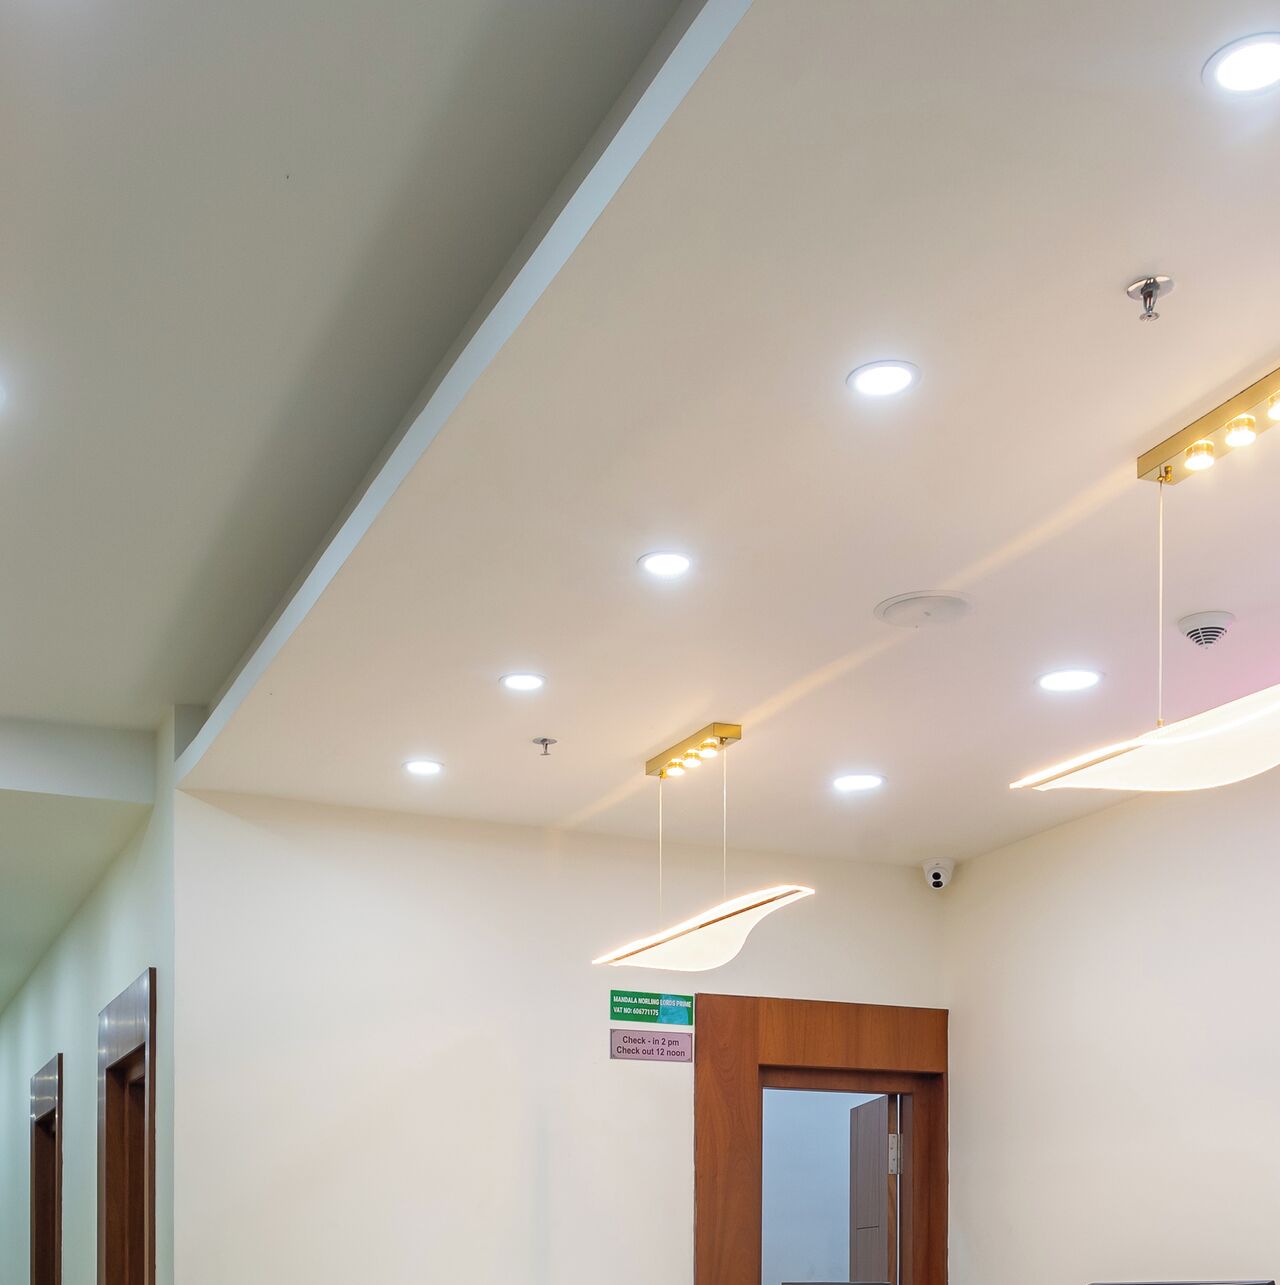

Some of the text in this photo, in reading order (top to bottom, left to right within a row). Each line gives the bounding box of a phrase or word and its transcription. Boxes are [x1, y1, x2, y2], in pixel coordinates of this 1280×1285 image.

[613, 996, 637, 1004] MANDALA
[622, 1035, 646, 1045] Check
[652, 1037, 660, 1045] in
[667, 1039, 680, 1047] pm
[616, 1046, 640, 1054] Check
[656, 1048, 665, 1056] 12
[666, 1049, 686, 1057] noon
